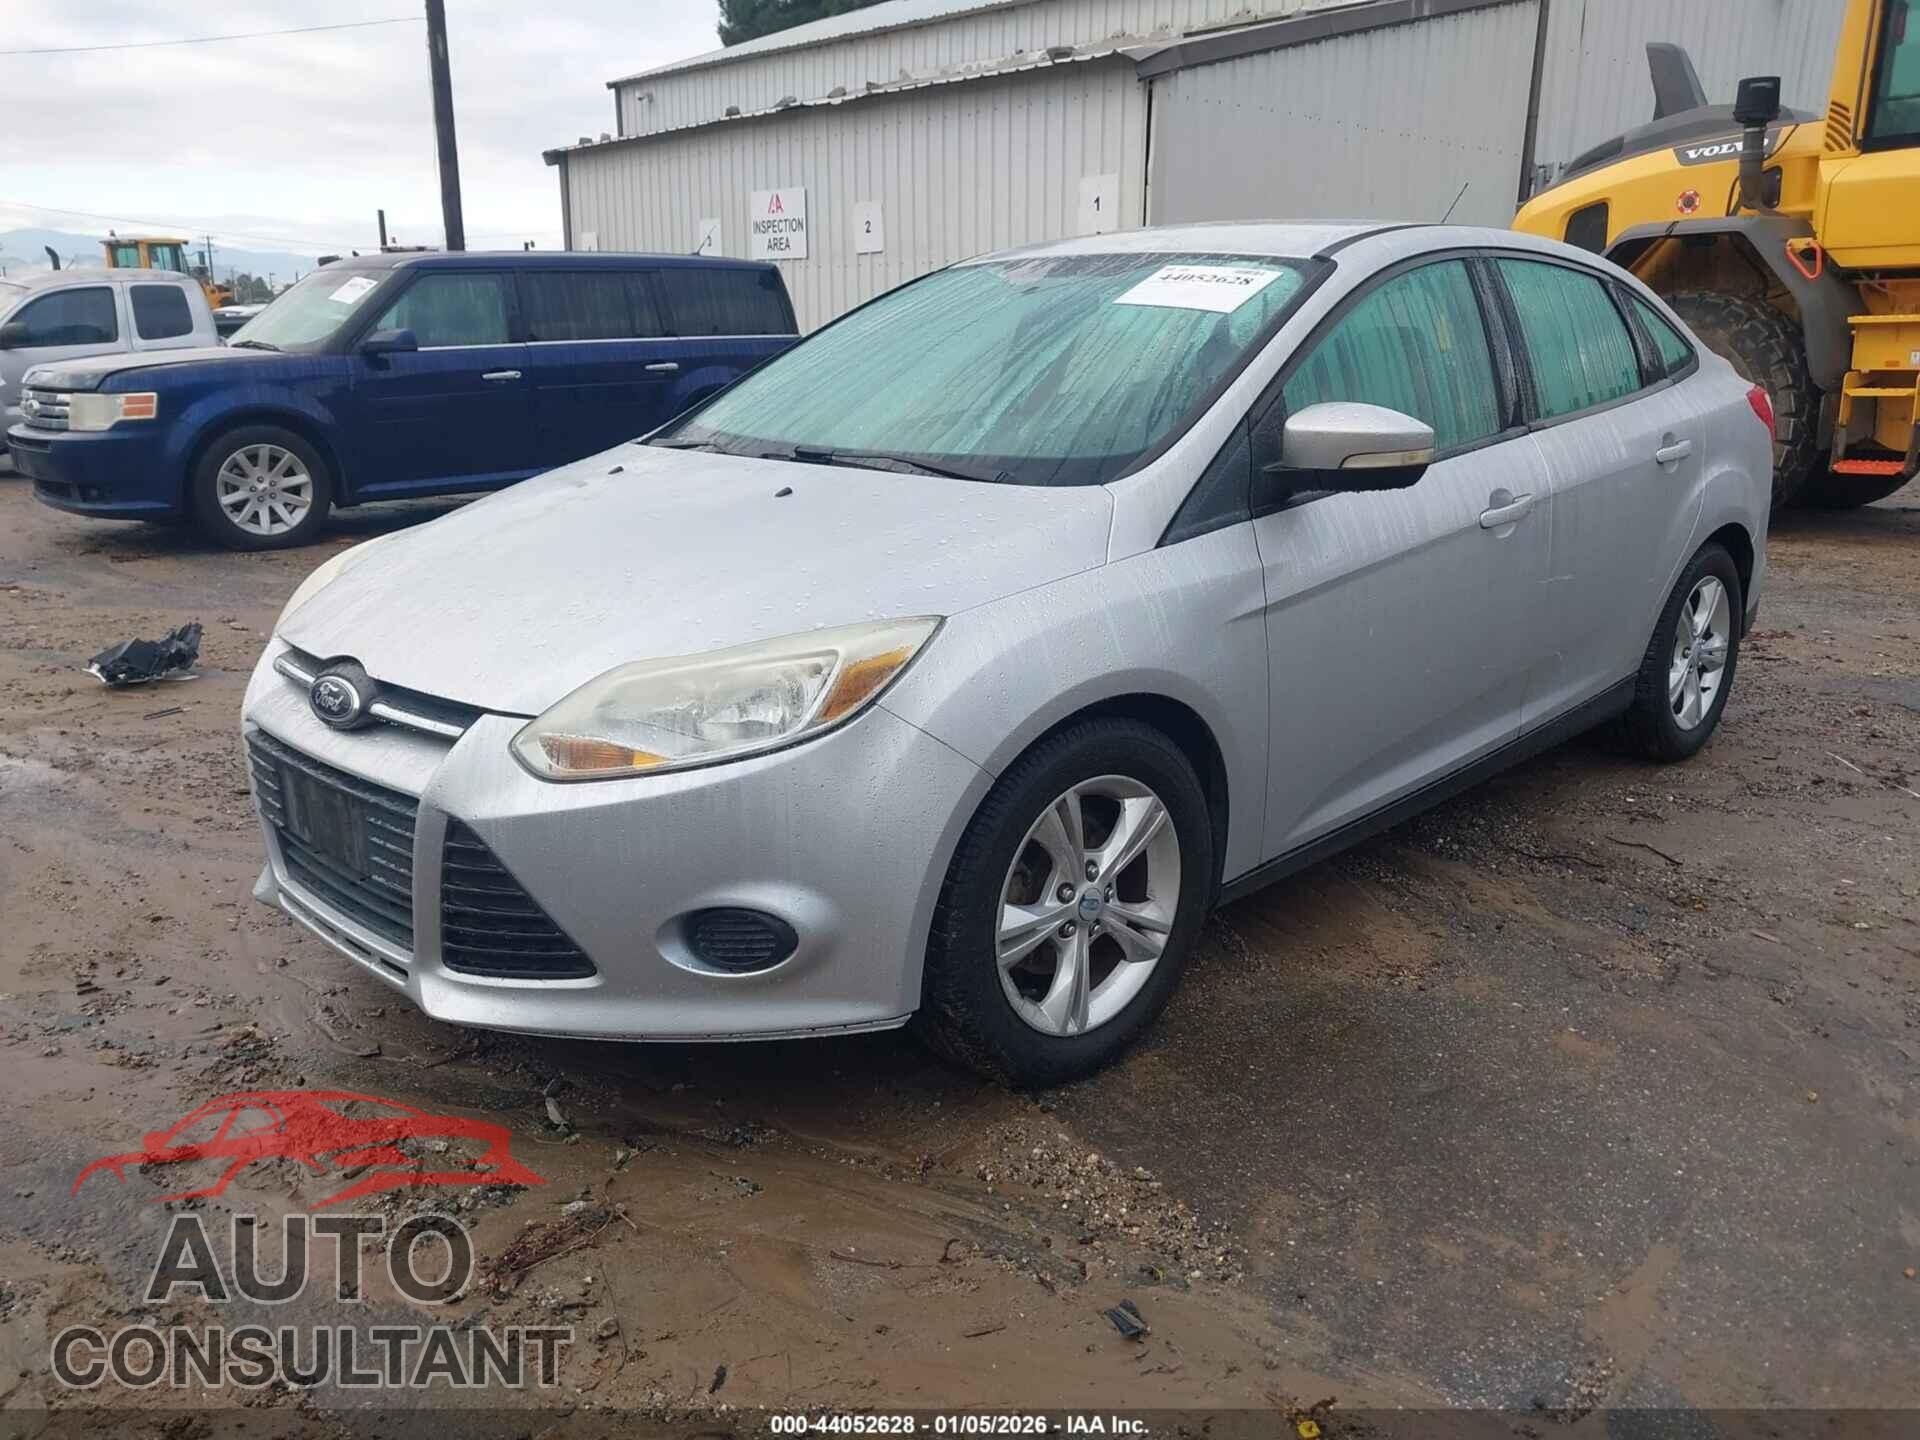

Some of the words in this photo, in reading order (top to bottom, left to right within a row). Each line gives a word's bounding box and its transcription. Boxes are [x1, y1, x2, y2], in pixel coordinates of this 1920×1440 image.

[1685, 137, 1769, 158] VOLV
[1094, 195, 1100, 211] 1
[753, 217, 804, 234] INSPECTION
[864, 220, 871, 233] 2
[767, 236, 791, 251] AREA
